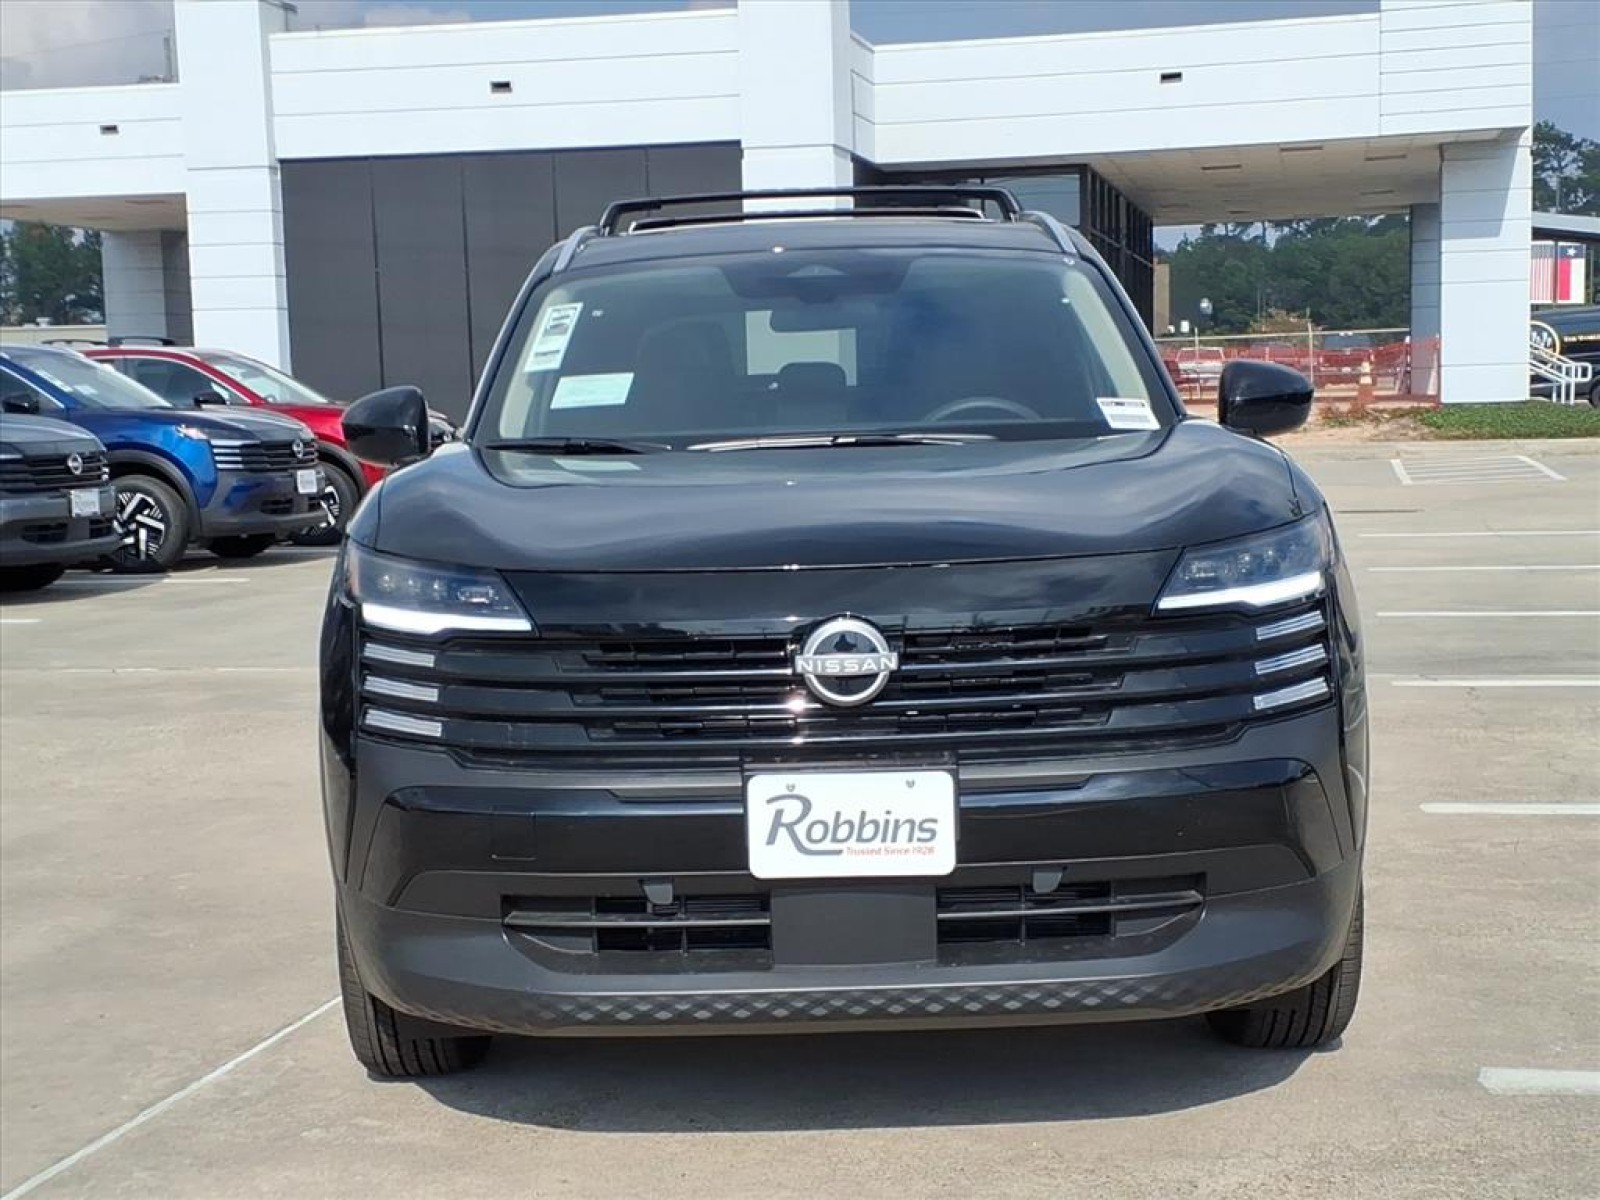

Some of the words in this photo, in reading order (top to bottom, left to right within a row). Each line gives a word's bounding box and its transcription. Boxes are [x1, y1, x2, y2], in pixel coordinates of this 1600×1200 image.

[797, 656, 897, 673] NISSAN
[766, 794, 938, 856] Robbins
[884, 846, 910, 856] Since
